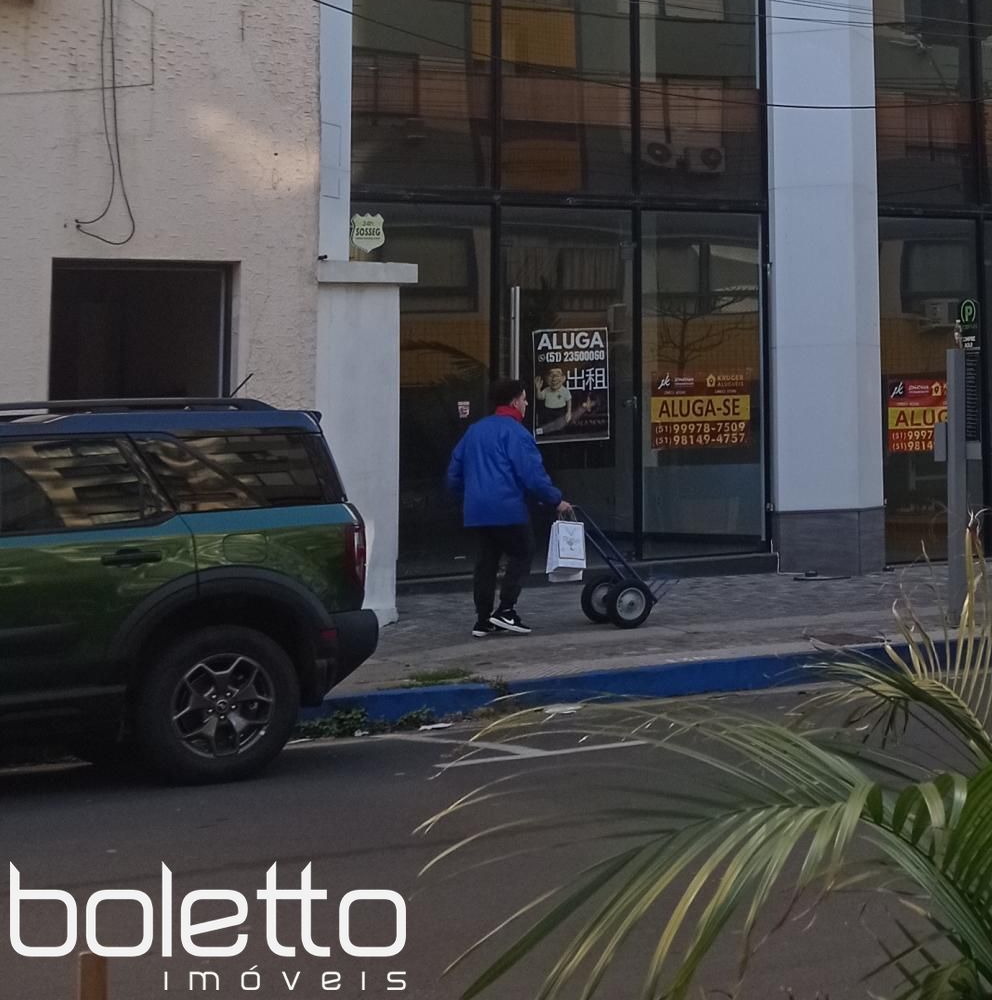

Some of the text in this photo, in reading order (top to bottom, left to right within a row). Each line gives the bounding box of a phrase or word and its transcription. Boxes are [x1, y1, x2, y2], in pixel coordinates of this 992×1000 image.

[355, 228, 381, 236] SOSSEG
[537, 331, 604, 350] ALUGA
[546, 352, 561, 362] (51)
[566, 367, 609, 391] 出租
[658, 398, 741, 418] ALUGA-SE
[655, 422, 746, 434] (51) 99978-7509
[673, 433, 745, 446] 98149-4757
